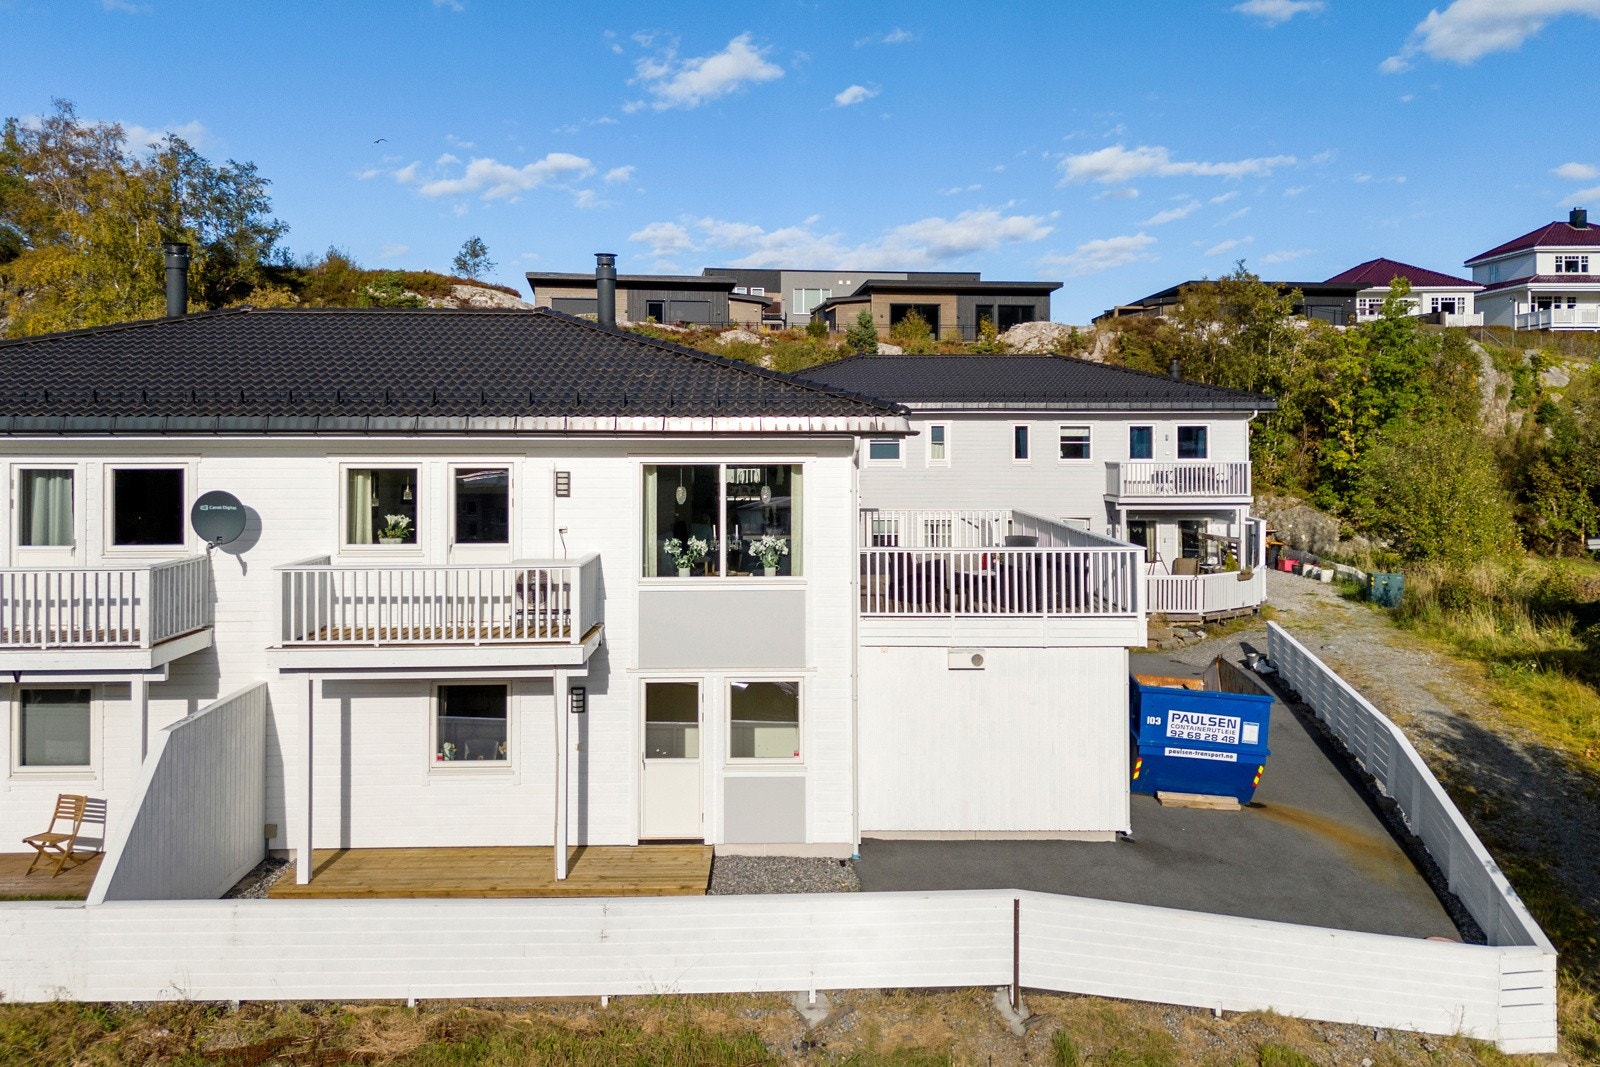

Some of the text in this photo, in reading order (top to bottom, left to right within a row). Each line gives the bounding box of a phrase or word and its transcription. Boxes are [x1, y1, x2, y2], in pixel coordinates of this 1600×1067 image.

[1147, 716, 1161, 725] 103
[1171, 713, 1237, 729] PAULSEN
[1170, 723, 1235, 735] CONTAINERUTLEIE
[1170, 730, 1184, 738] 92
[1187, 731, 1201, 740] 68
[1204, 733, 1218, 742] 28
[1221, 735, 1235, 744] 48
[1168, 748, 1233, 759] paulsen-transport.no
